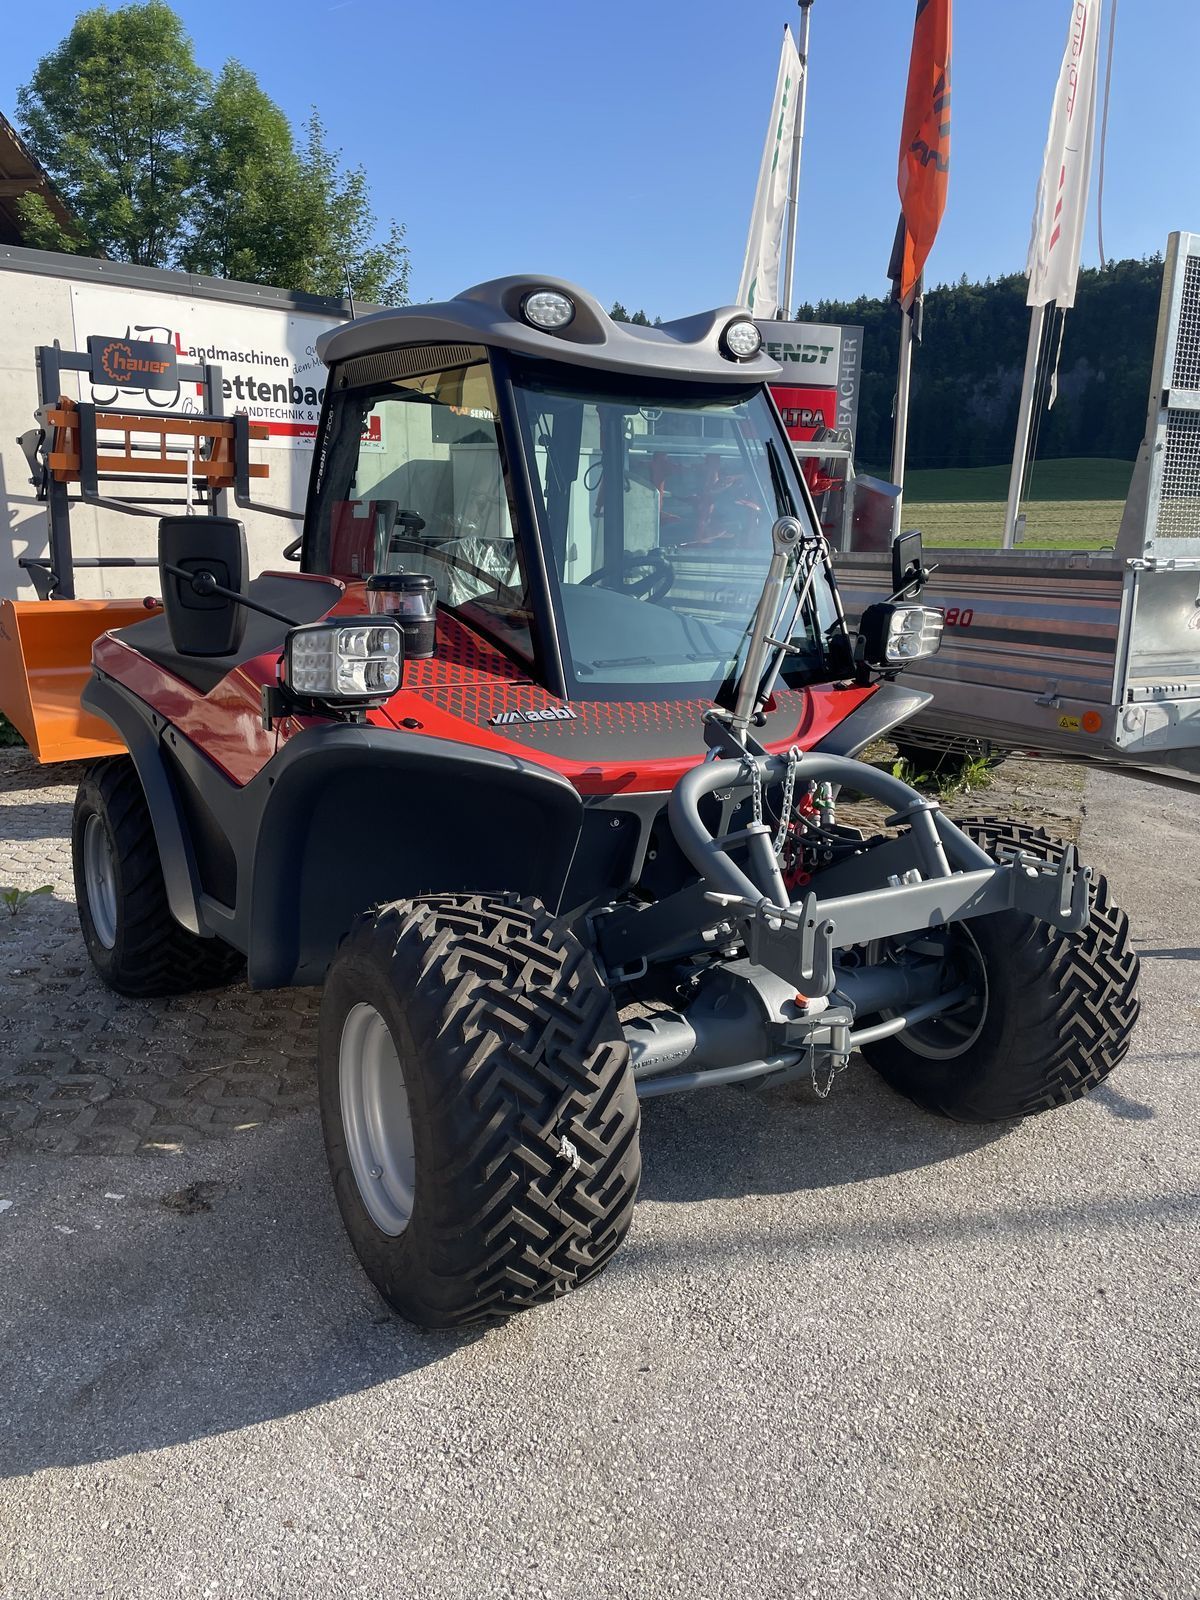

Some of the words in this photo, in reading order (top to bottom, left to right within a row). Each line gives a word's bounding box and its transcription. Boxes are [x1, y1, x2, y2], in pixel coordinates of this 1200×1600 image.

[175, 332, 289, 367] Landmaschinen
[305, 345, 317, 356] Qu
[761, 342, 834, 364] ENDT
[113, 352, 170, 374] hauer
[292, 363, 311, 375] dem
[838, 338, 857, 427] BACHER
[307, 410, 314, 421] &
[781, 407, 825, 427] LTRA
[525, 705, 578, 721] aebi
